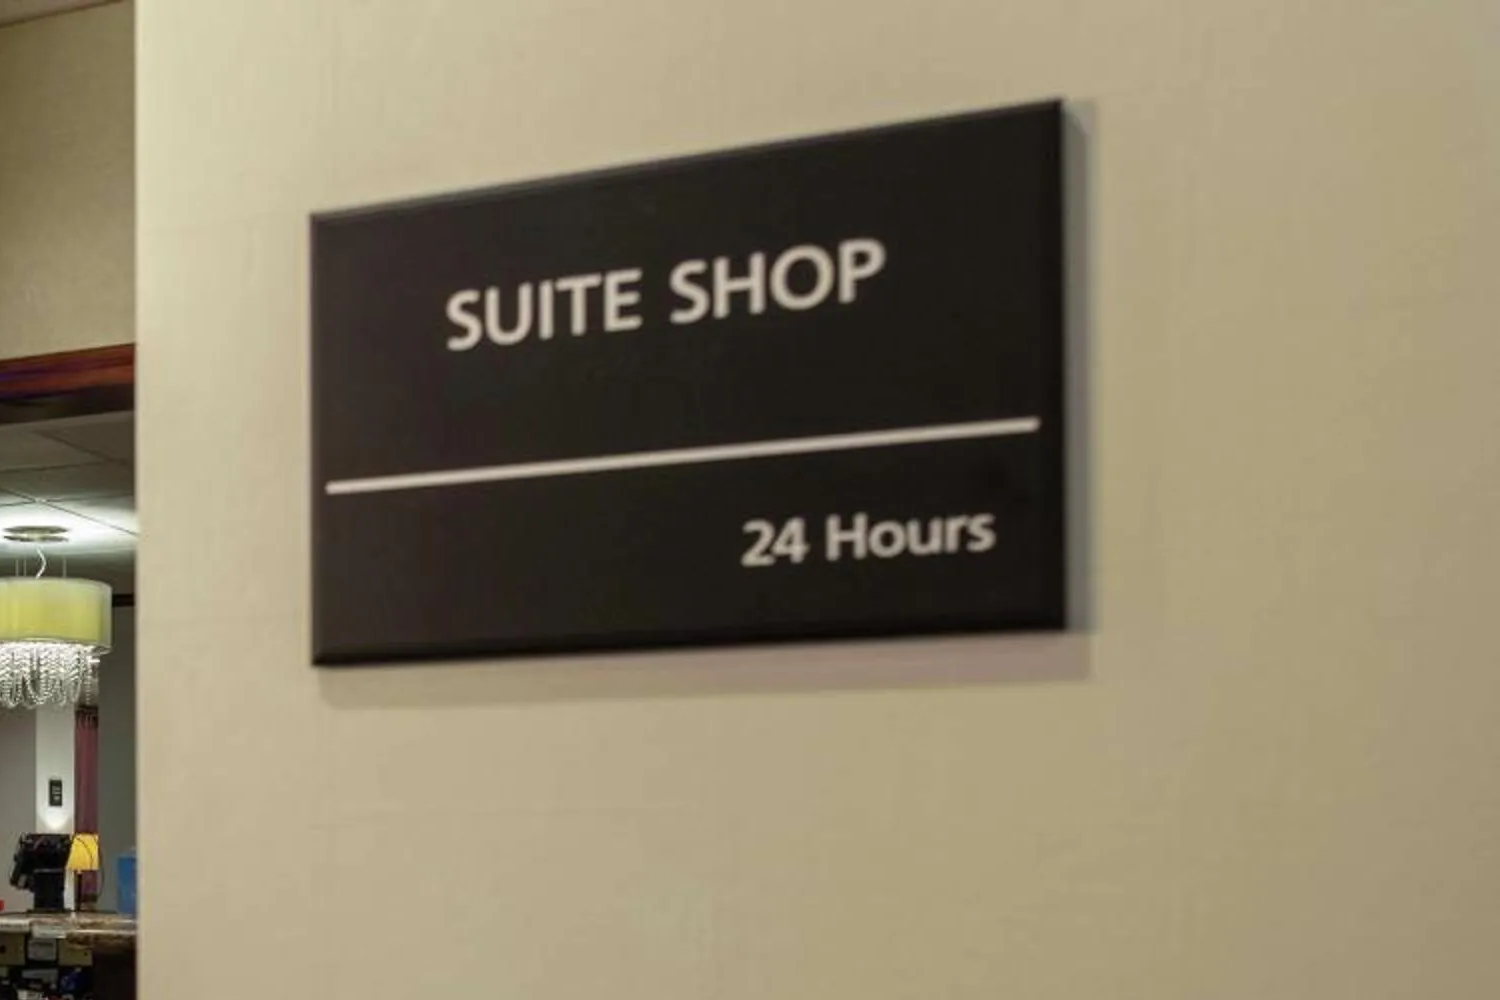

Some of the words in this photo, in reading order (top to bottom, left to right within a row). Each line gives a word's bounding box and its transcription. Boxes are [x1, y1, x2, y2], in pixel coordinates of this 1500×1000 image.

[446, 267, 643, 351] SUITE
[670, 237, 887, 324] SHOP
[741, 517, 810, 567] 24
[825, 512, 996, 561] Hours
